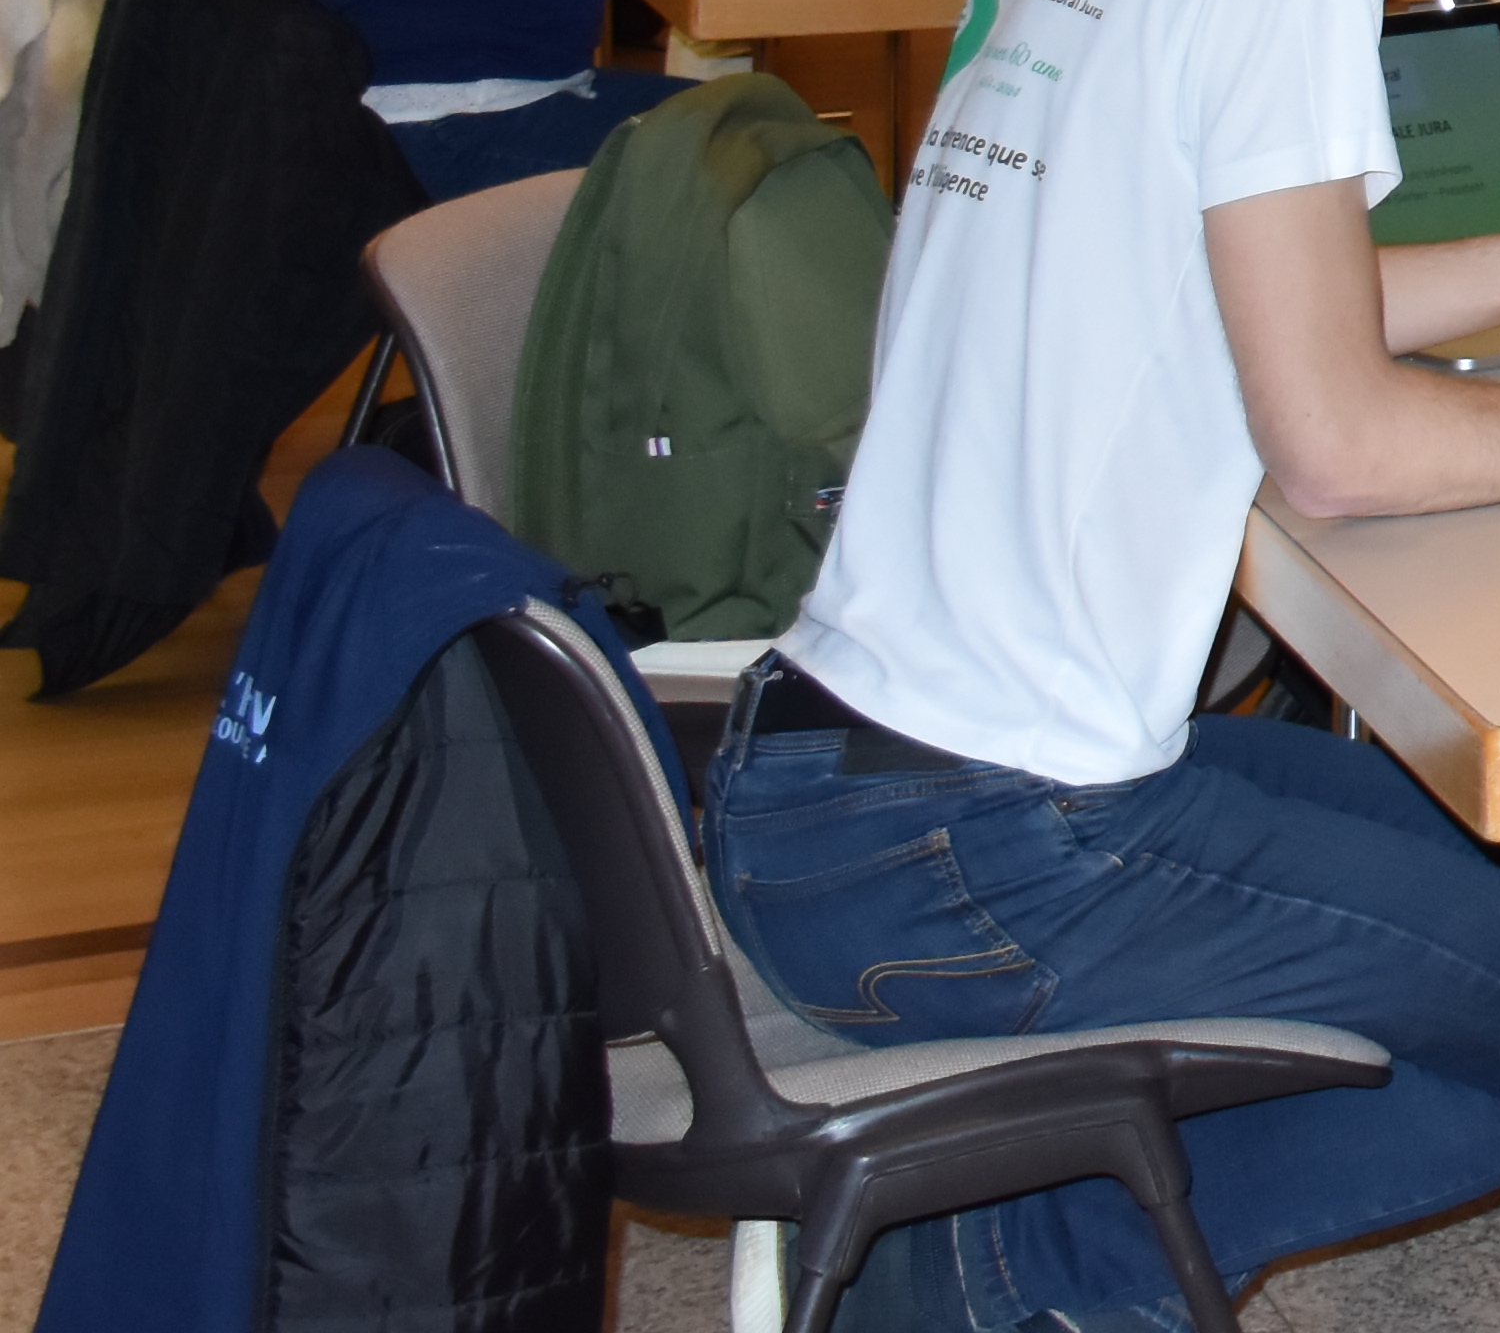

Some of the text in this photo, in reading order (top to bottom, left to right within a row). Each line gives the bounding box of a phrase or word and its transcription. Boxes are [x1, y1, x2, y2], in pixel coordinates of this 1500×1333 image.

[1079, 0, 1105, 21] Jura
[1417, 118, 1453, 137] JURA
[987, 141, 1028, 170] que
